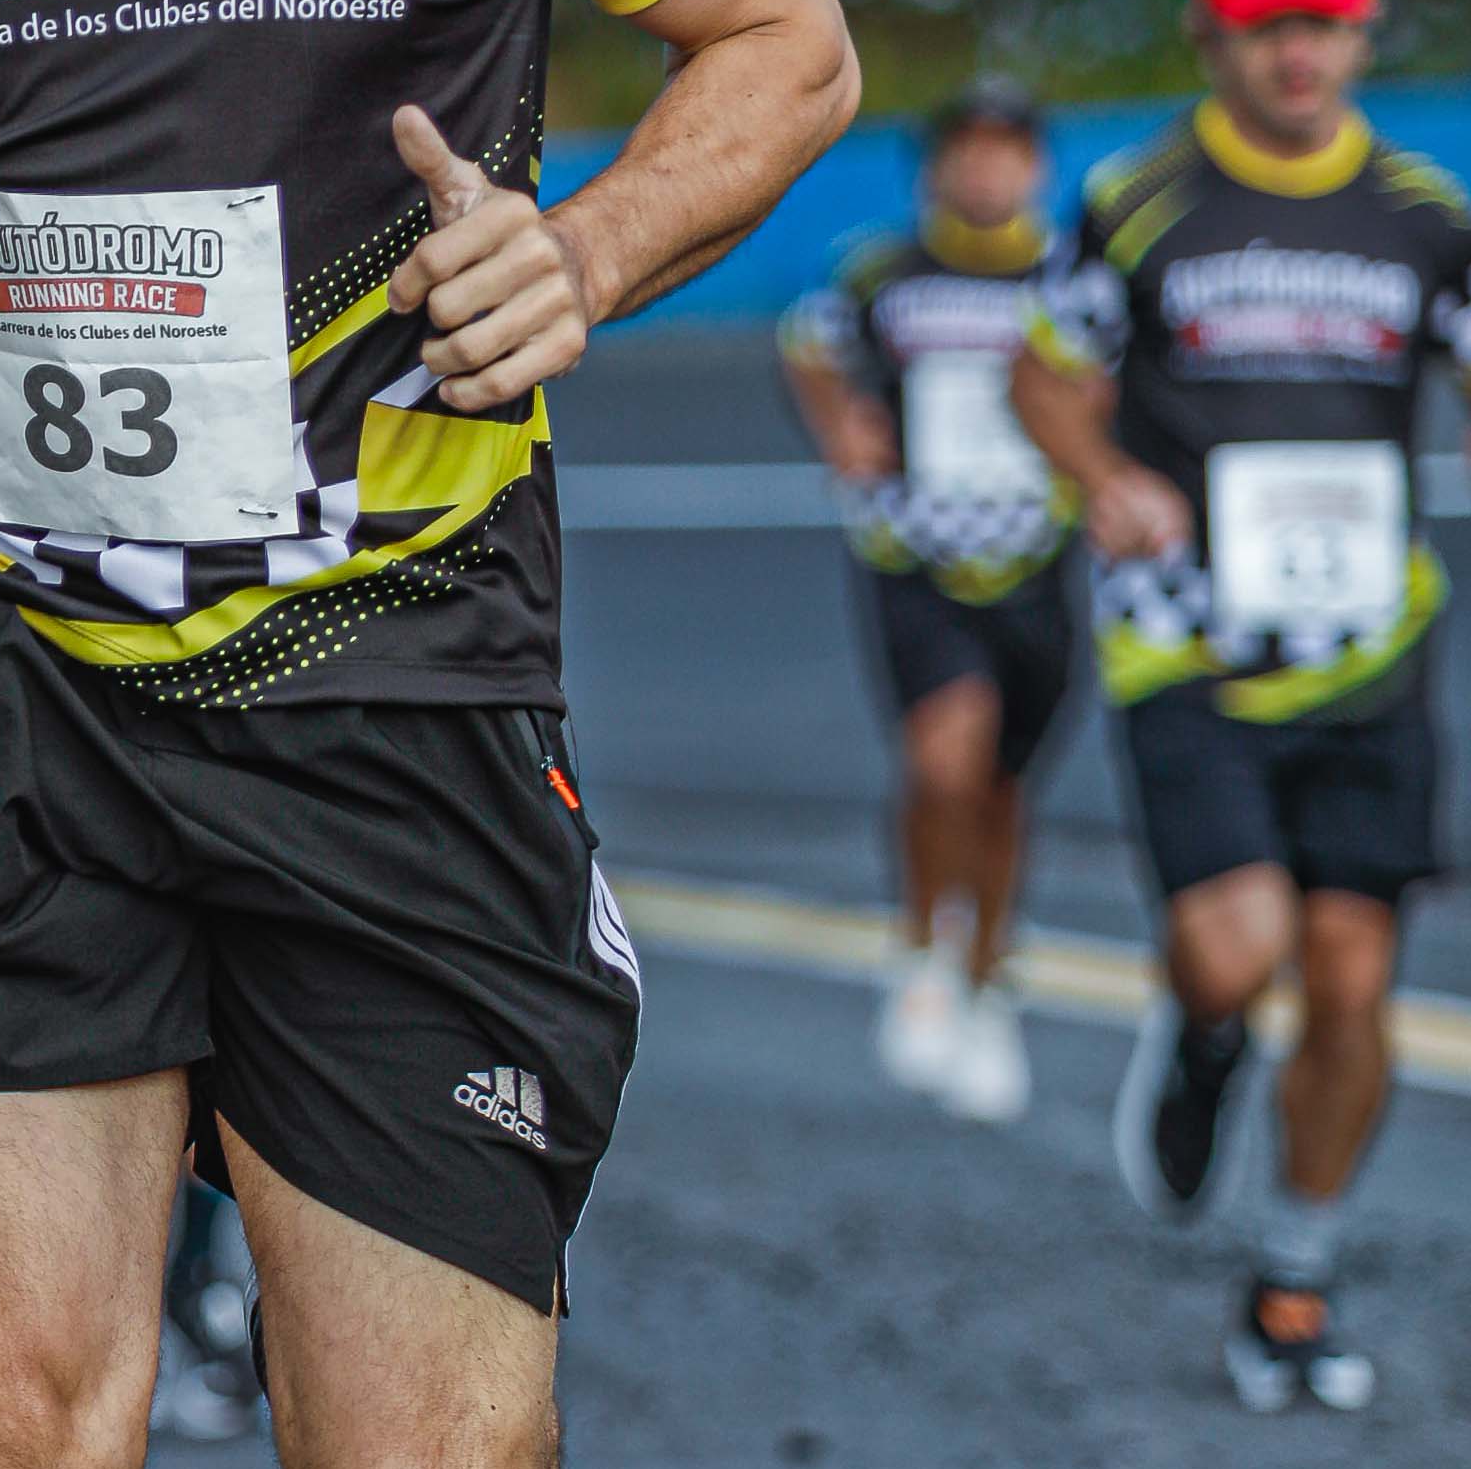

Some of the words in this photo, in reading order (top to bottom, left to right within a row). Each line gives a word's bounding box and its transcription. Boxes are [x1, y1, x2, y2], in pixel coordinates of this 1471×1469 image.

[21, 12, 57, 41] de
[65, 8, 107, 37] los
[115, 0, 210, 32] Clubes
[8, 282, 105, 309] RUNNING
[113, 283, 177, 312] RACE
[38, 323, 53, 338] de
[56, 324, 76, 339] los
[80, 324, 128, 339] Clubes
[133, 324, 156, 339] del
[160, 323, 227, 338] Noroeste
[23, 363, 178, 477] 83
[453, 1084, 548, 1150] adidas
